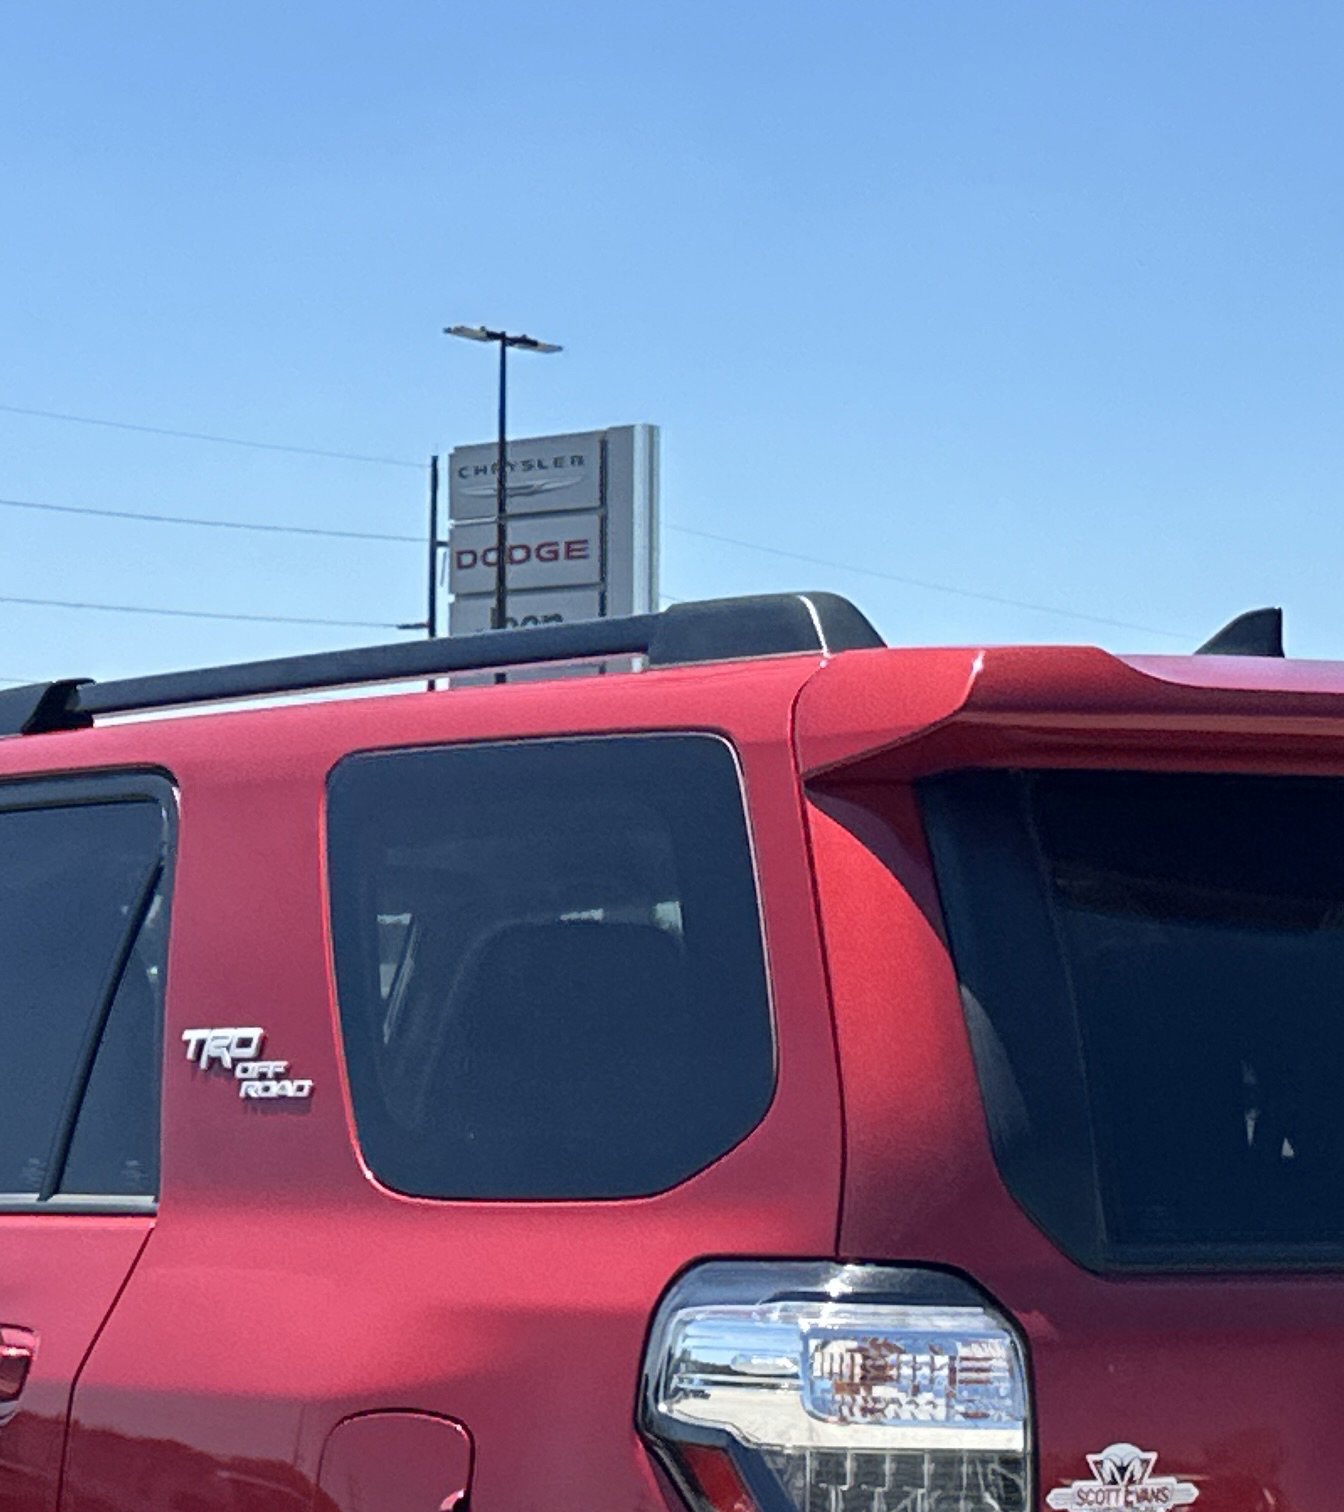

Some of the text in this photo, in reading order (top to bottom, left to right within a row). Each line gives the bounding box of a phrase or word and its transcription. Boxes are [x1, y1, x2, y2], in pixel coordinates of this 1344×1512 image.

[458, 454, 585, 479] CHRYSLER
[456, 539, 590, 570] DODGE
[182, 1027, 264, 1070] TRD
[235, 1061, 288, 1079] OFF
[239, 1080, 313, 1098] ROAD
[1076, 1487, 1121, 1507] SCOTT
